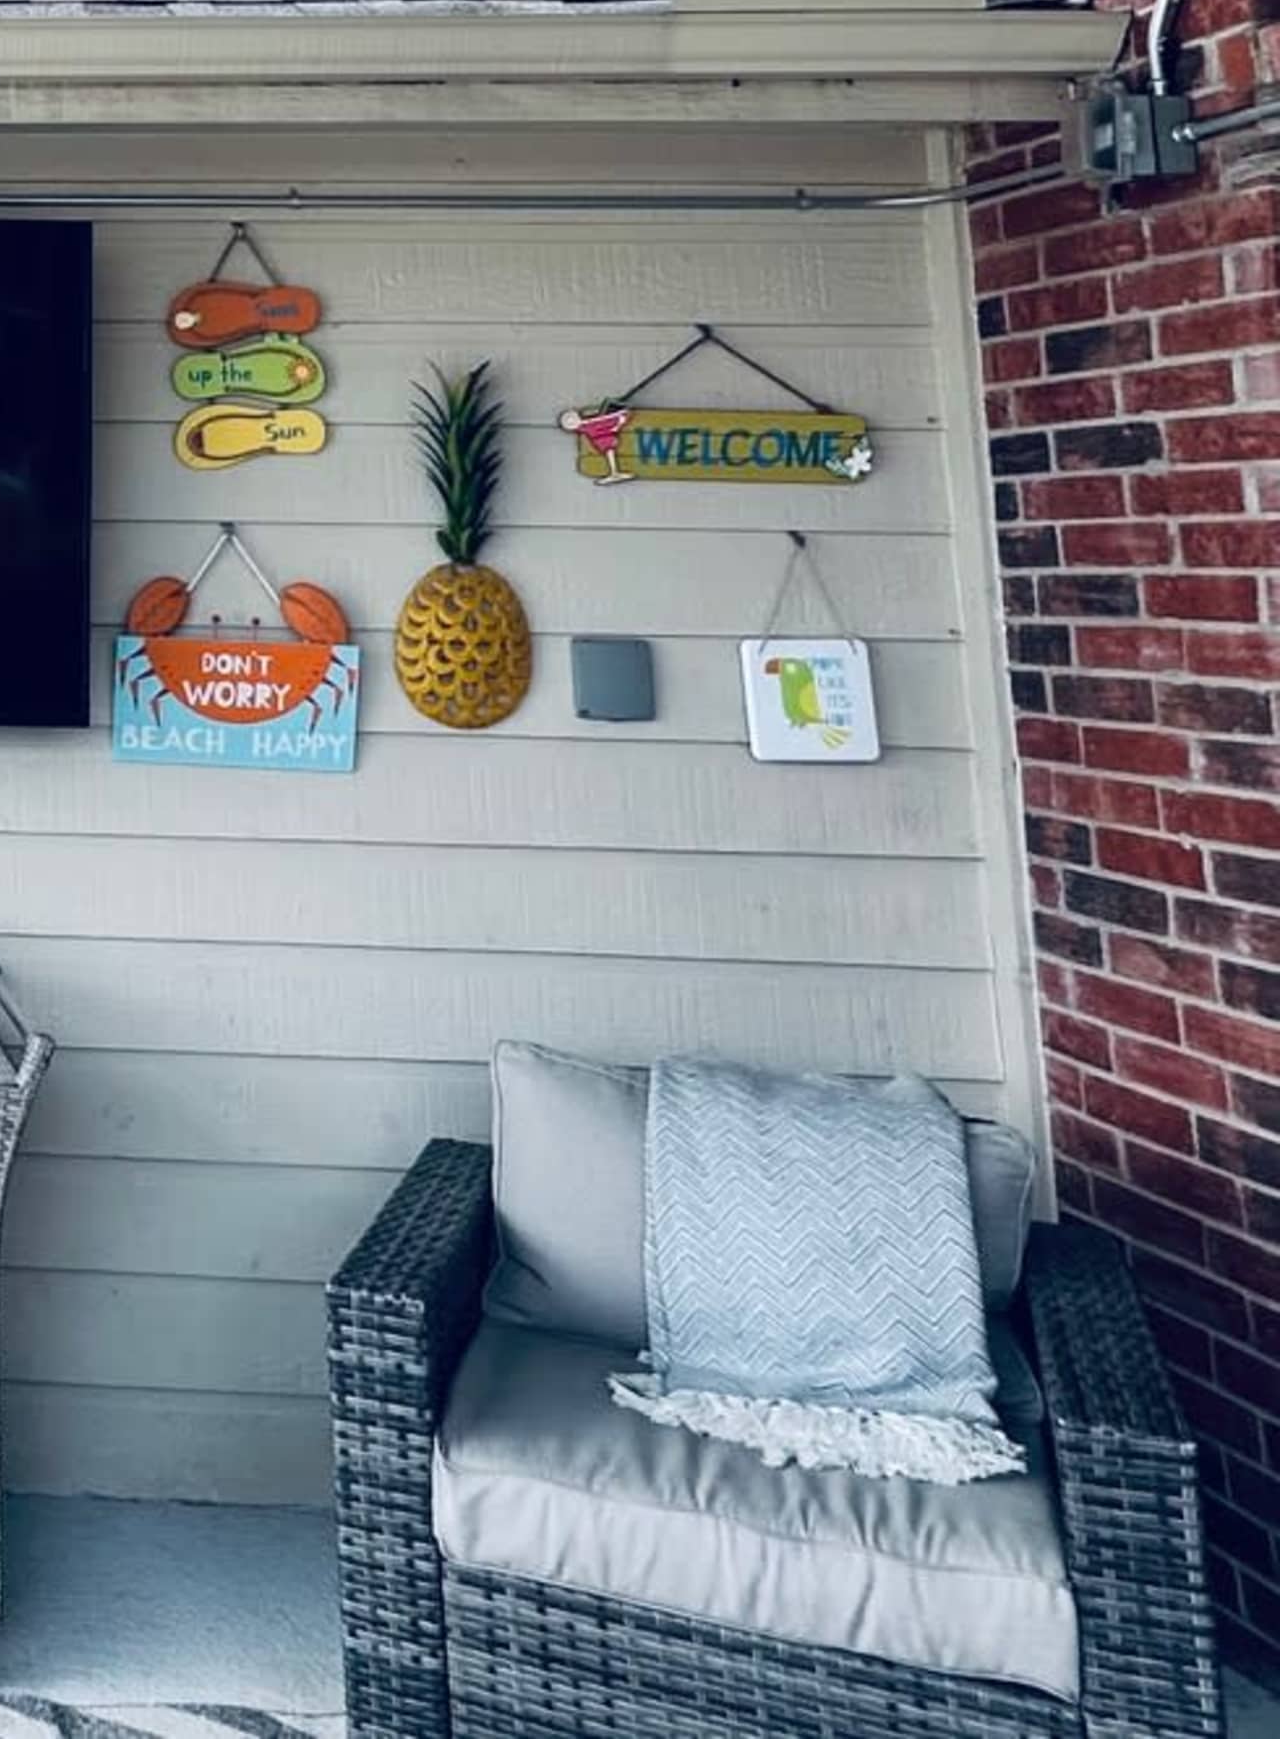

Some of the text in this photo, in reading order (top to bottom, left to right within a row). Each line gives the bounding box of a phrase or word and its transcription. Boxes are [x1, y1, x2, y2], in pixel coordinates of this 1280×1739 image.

[188, 363, 252, 389] up the
[264, 423, 306, 441] Sun
[634, 428, 844, 468] WELCOME
[182, 680, 291, 710] WORRY
[121, 725, 347, 760] BEACH HAPPY
